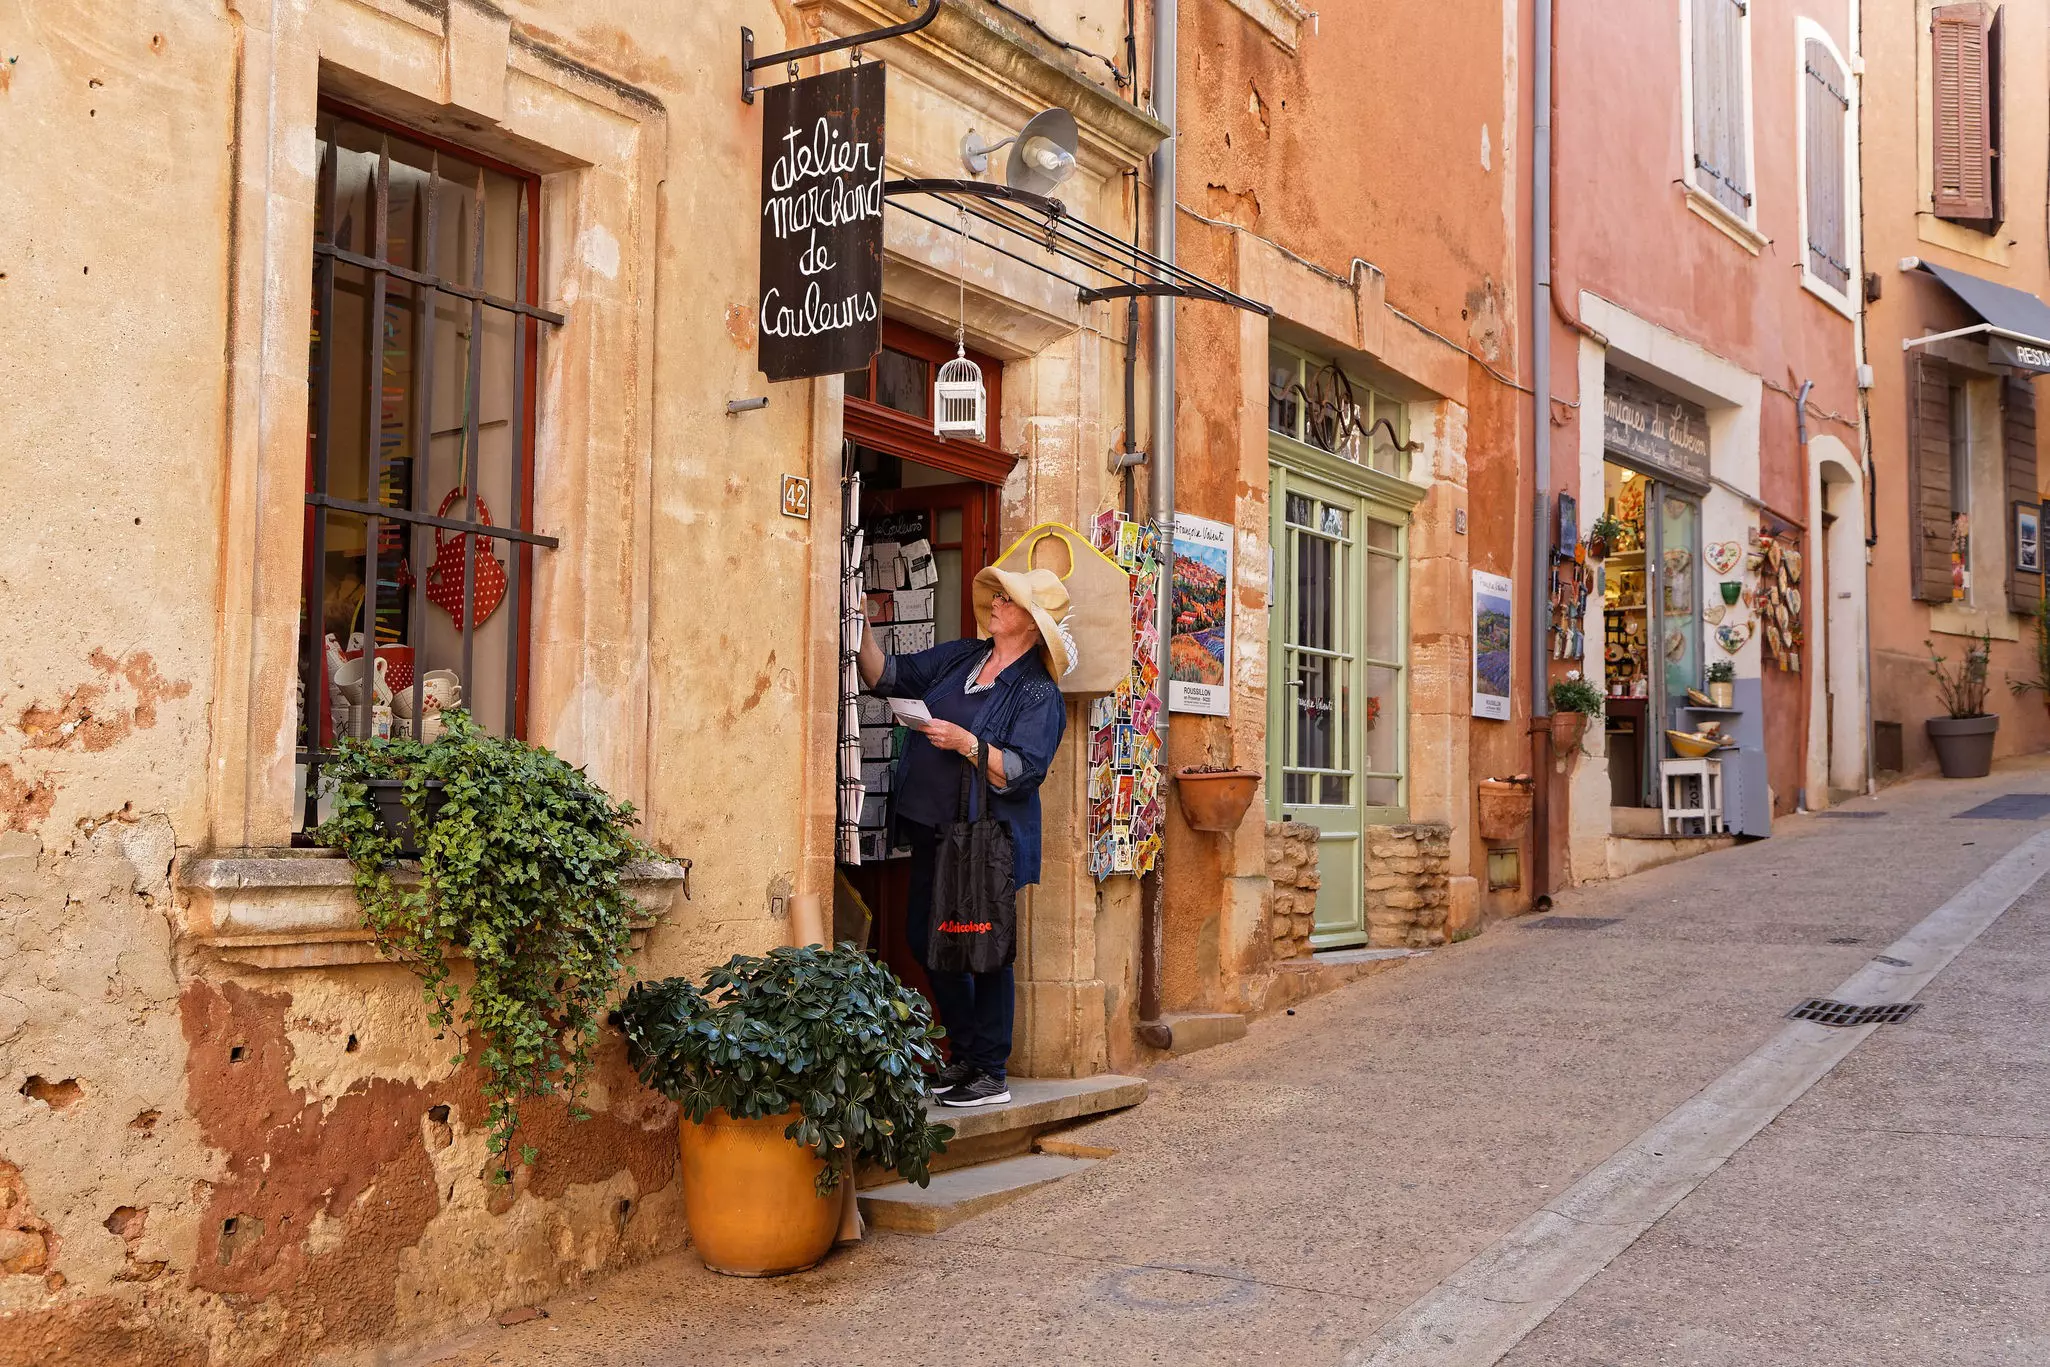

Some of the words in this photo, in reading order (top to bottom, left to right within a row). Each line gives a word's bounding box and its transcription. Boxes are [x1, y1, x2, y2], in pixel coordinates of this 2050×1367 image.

[771, 117, 876, 192] atelier
[765, 156, 882, 239] marchand
[800, 228, 836, 276] de
[761, 282, 877, 338] Couleurs
[1651, 403, 1666, 440] du
[786, 484, 806, 507] 42
[1184, 687, 1211, 696] ROUSSILLON
